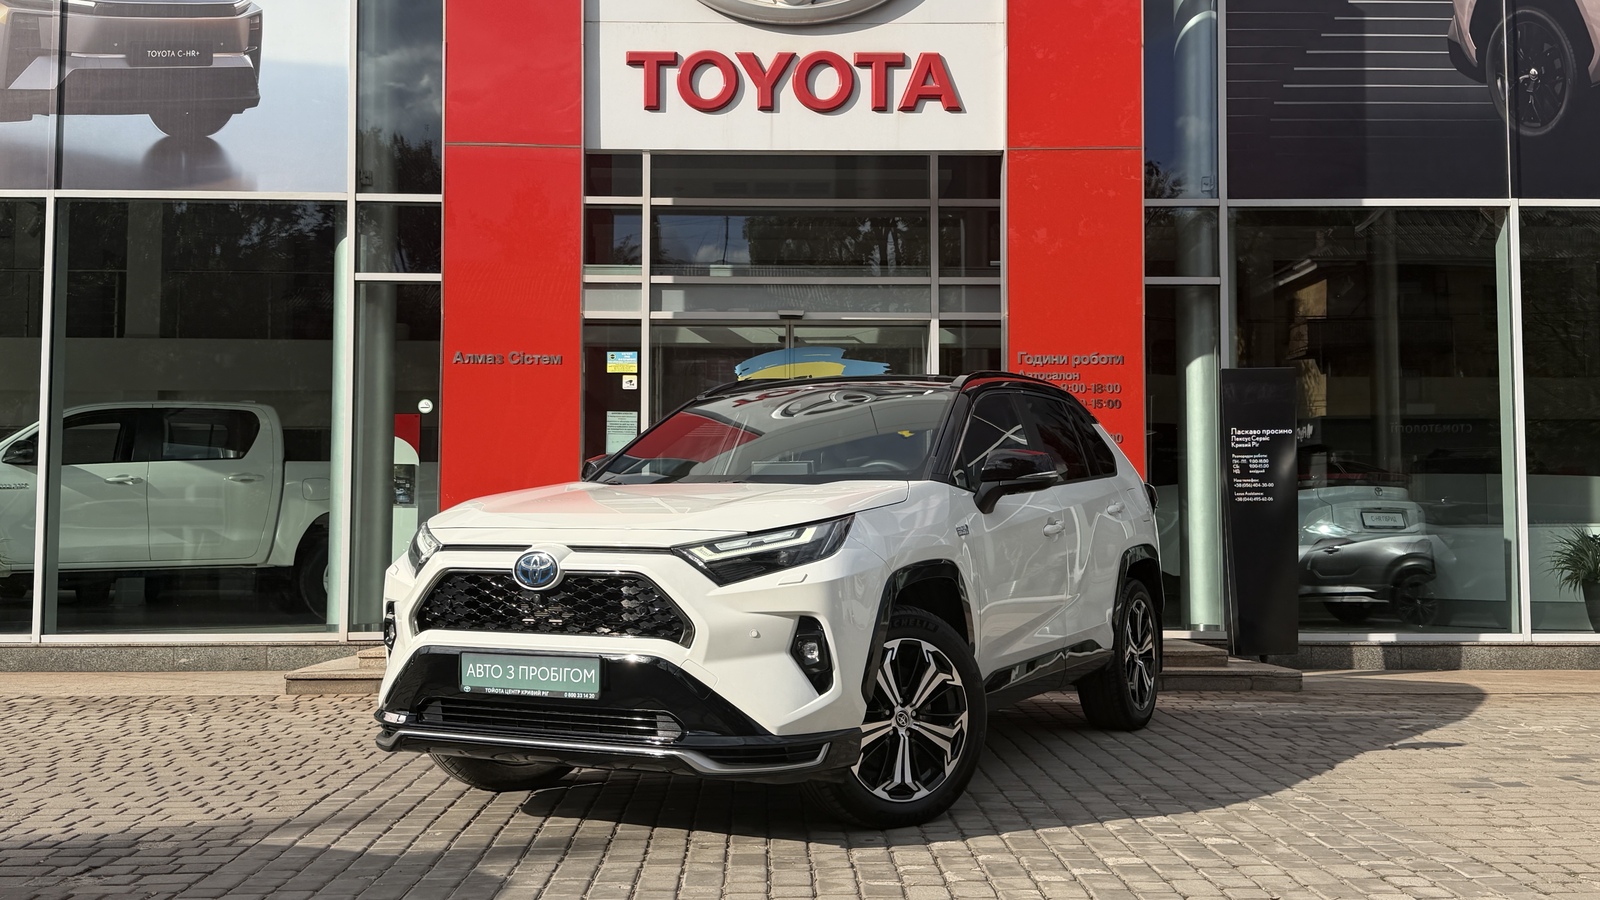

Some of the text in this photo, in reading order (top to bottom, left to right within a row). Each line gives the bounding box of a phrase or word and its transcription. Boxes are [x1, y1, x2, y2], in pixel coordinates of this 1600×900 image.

[147, 49, 200, 58] TOYOTA C-HR+
[626, 50, 963, 112] TOYOTA
[453, 351, 562, 365] Алмаз Сістем
[1017, 351, 1124, 368] Години роботи
[1061, 383, 1121, 394] 9:00-18:00
[466, 663, 503, 679] АВТО
[519, 665, 595, 683] ПРОБІГОМ
[485, 687, 504, 695] ТОЙОТА
[521, 689, 541, 697] КРИВИЙ
